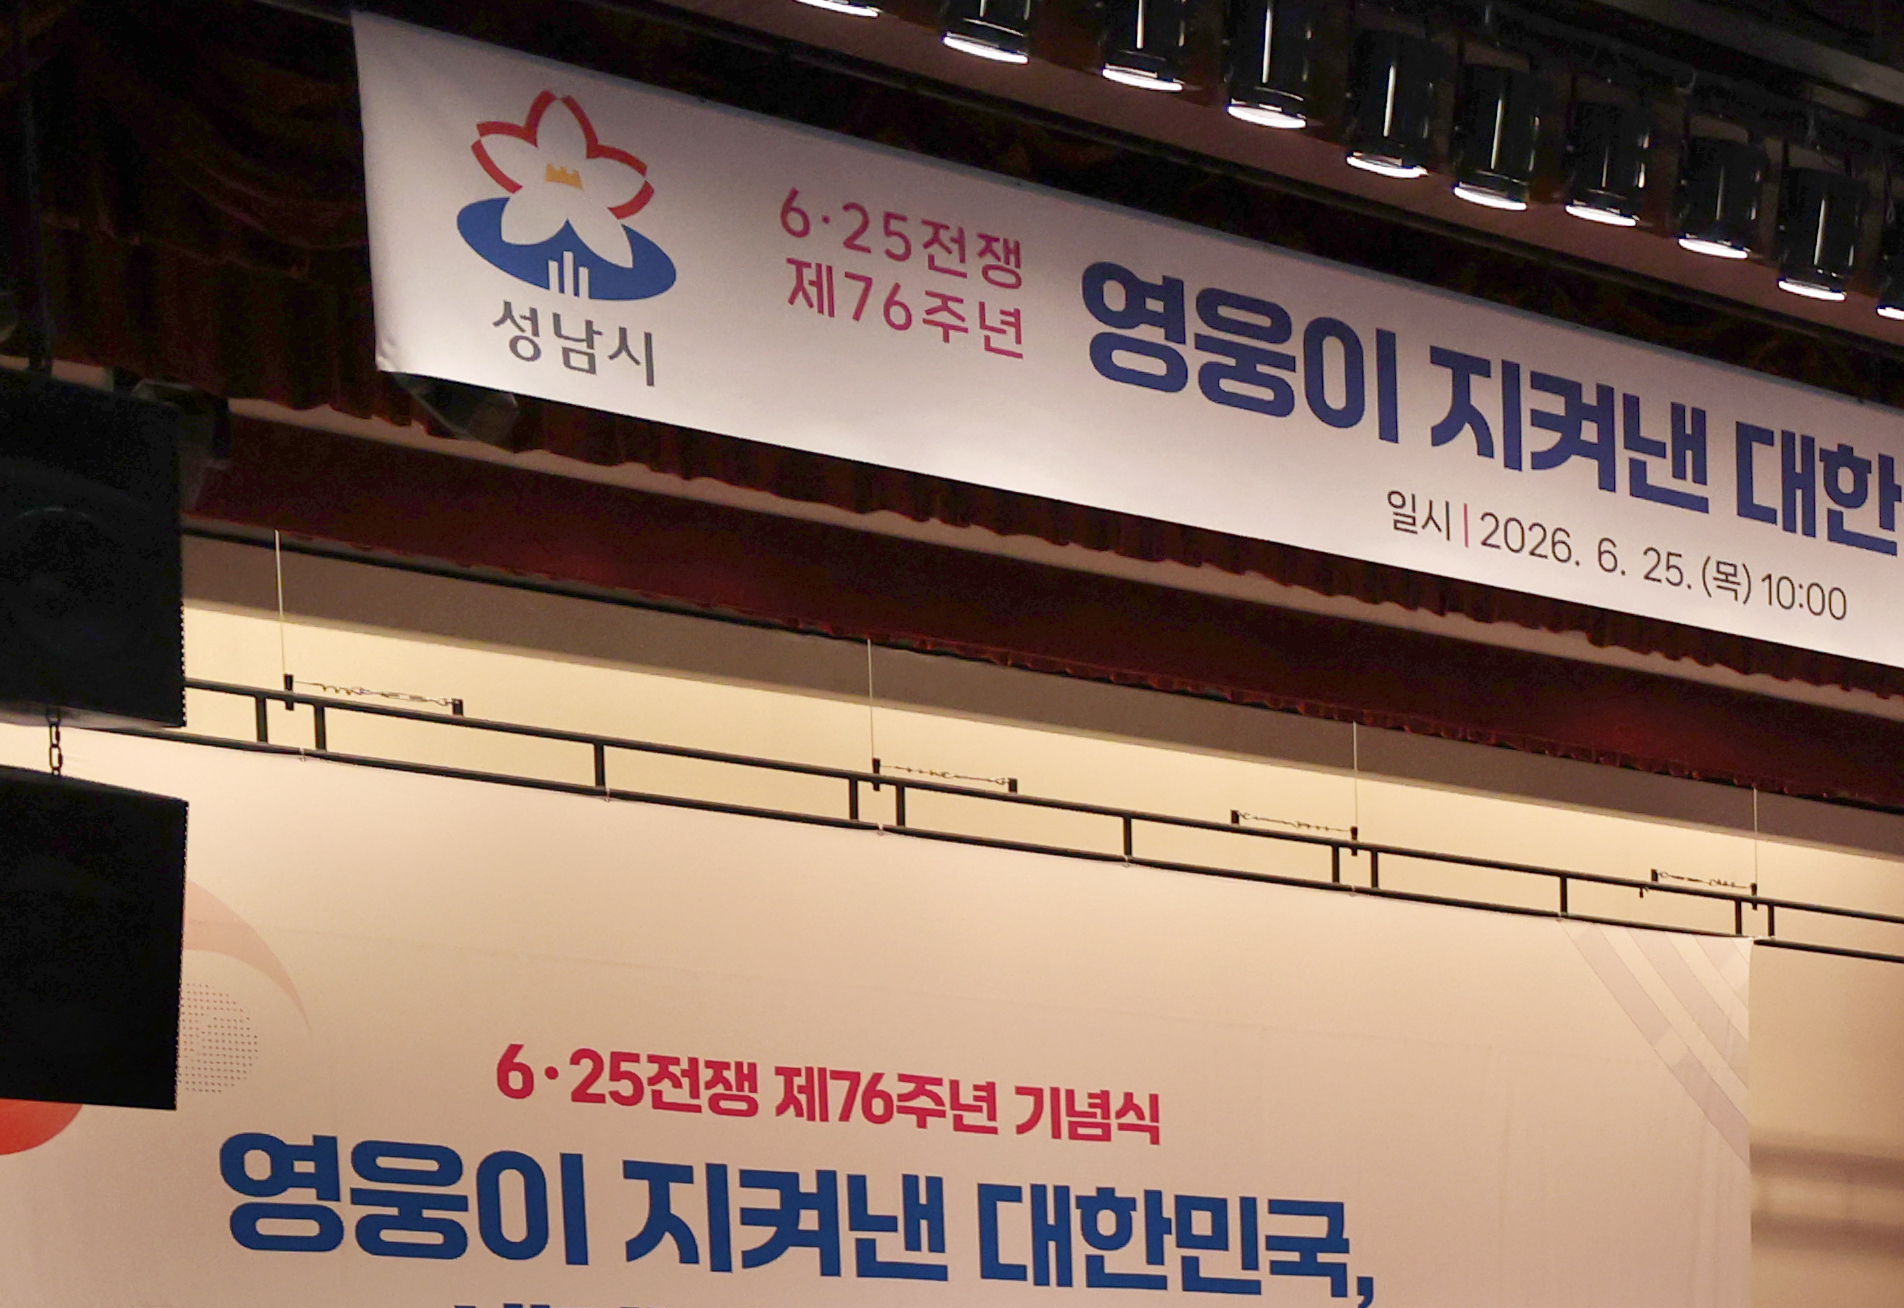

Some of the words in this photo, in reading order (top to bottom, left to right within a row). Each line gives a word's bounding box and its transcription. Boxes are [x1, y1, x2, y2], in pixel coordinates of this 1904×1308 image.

[493, 301, 654, 386] 성남시
[787, 258, 1023, 359] 제76주년
[1082, 262, 1399, 444] 영웅이
[1430, 345, 1709, 514] 지켜낸
[1387, 491, 1450, 541] 일시
[1481, 512, 1579, 566] 2026.
[1598, 538, 1625, 575] 6.
[1762, 574, 1846, 620] 10:00
[775, 1066, 998, 1135] 제76주년
[1015, 1086, 1160, 1145] 기념식
[219, 1132, 589, 1266] 영웅이
[622, 1160, 948, 1281] 지켜낸
